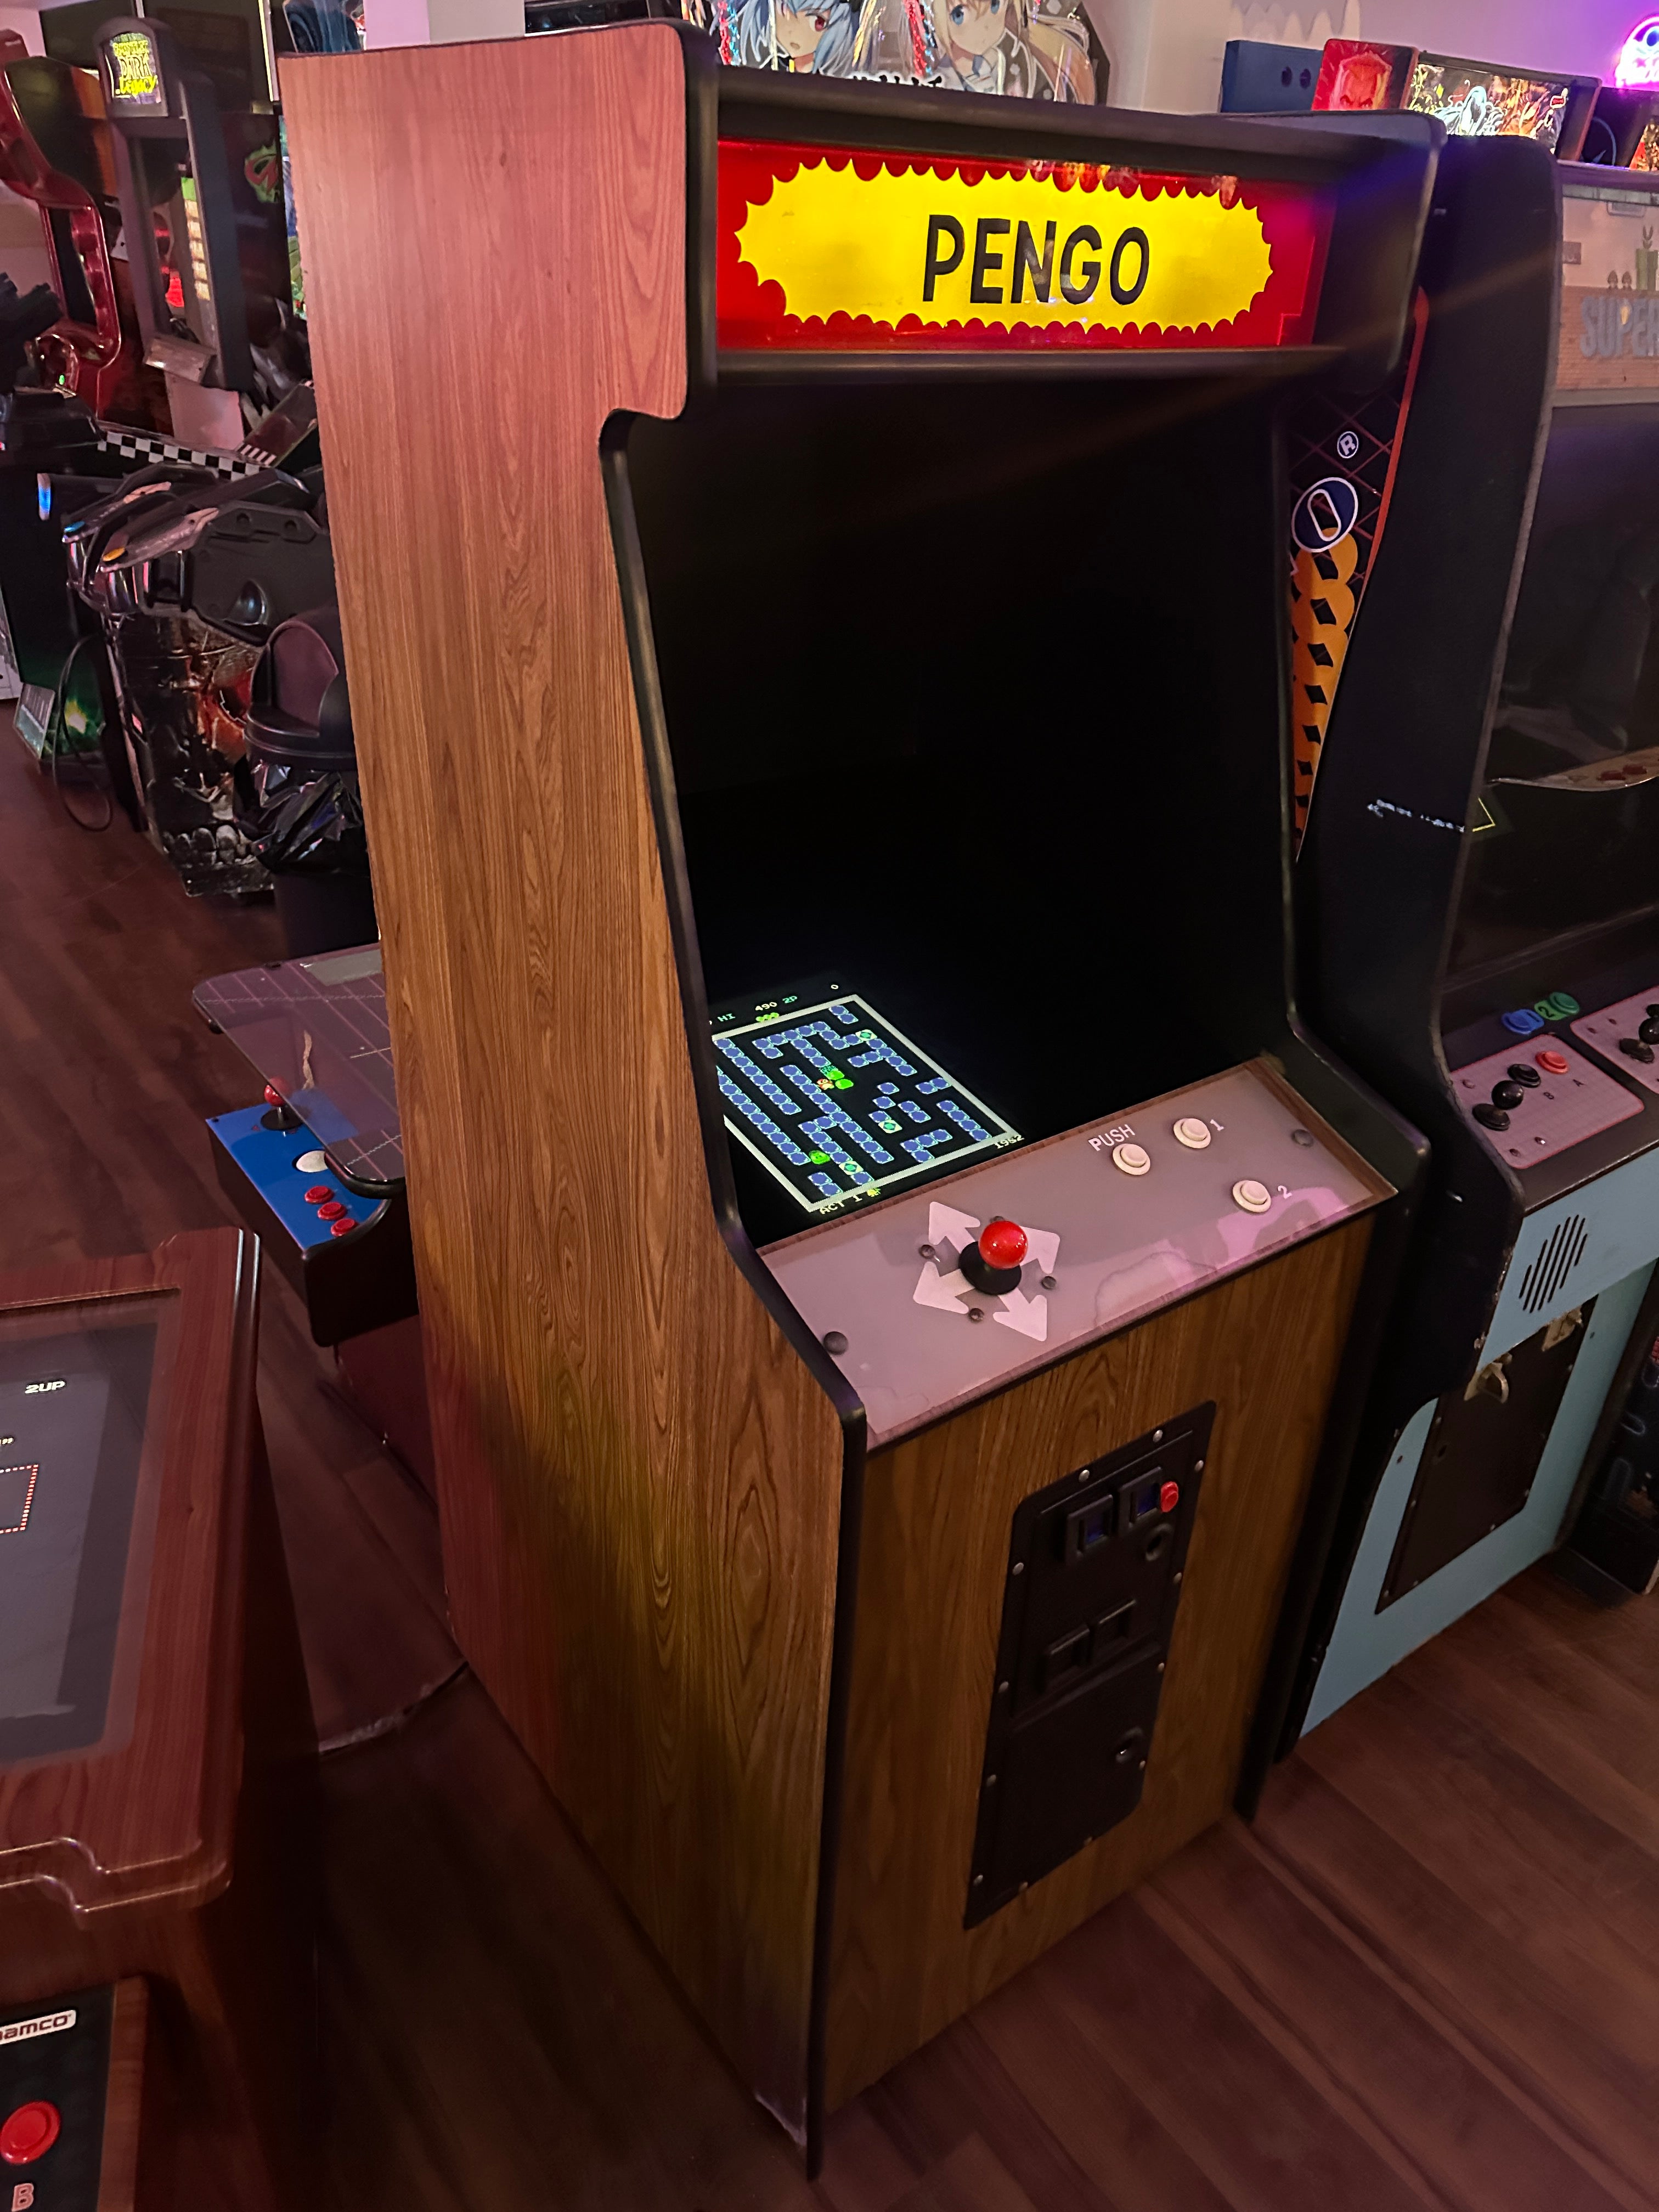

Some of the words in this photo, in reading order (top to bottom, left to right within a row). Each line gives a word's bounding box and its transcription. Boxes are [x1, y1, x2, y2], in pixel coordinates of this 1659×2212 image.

[923, 214, 1149, 305] PENGO
[717, 1013, 736, 1023] HI
[755, 1001, 778, 1011] 490
[782, 995, 798, 1004] 2P
[1538, 1005, 1555, 1018] 2
[1210, 1119, 1224, 1132] 1
[995, 1134, 1025, 1149] 1982
[1088, 1124, 1136, 1152] PUSH
[1277, 1185, 1293, 1199] 2
[819, 1200, 845, 1215] ACT
[25, 1380, 66, 1394] 2UP
[0, 2015, 68, 2040] amco
[12, 2183, 35, 2212] B
